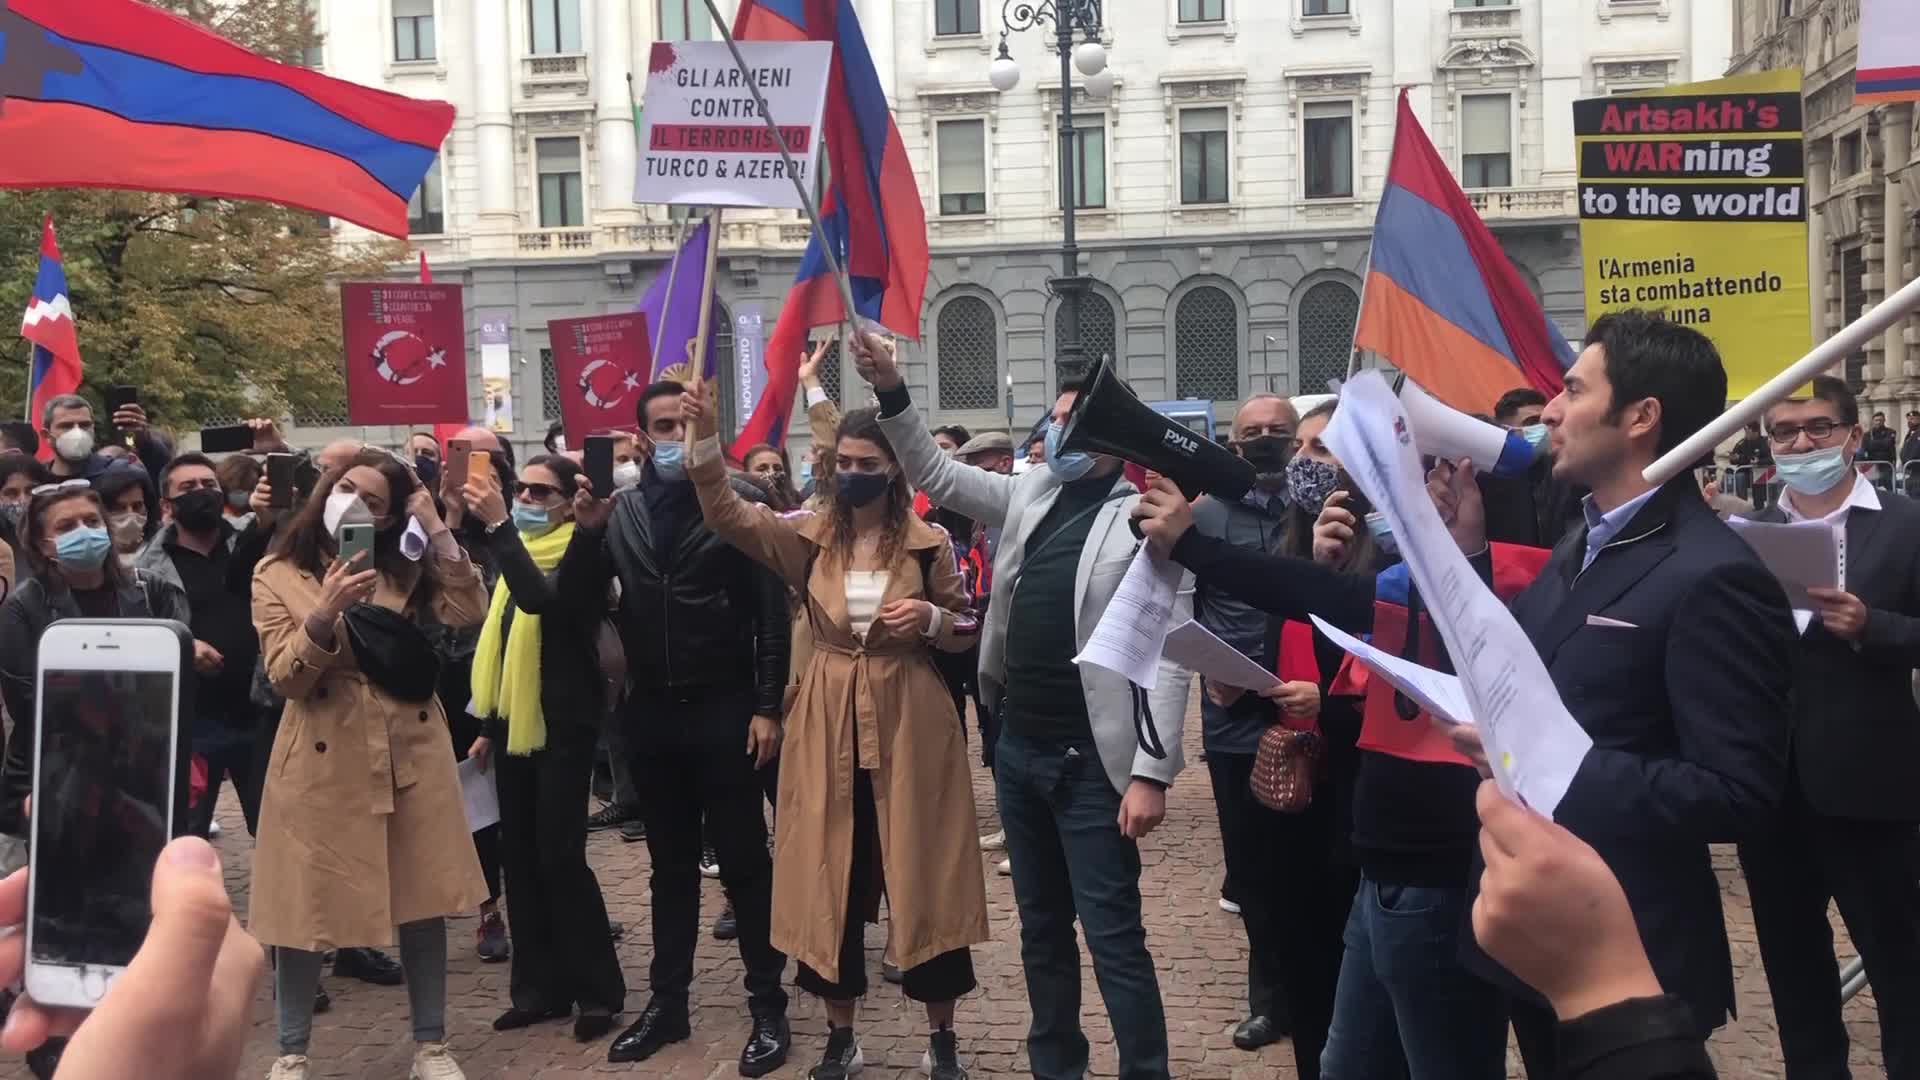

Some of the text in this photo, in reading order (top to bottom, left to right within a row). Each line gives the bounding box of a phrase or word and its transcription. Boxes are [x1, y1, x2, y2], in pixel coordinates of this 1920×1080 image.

[677, 68, 707, 87] GLI
[691, 98, 769, 118] CONTRO
[1600, 99, 1780, 133] Artsakh's
[652, 128, 668, 146] IL
[646, 158, 708, 177] TURCO
[715, 159, 727, 178] &
[1603, 142, 1774, 177] WARning
[1582, 186, 1801, 215] to the world
[1599, 252, 1696, 279] l'Armenia
[1600, 271, 1782, 305] sta combattendo
[1671, 307, 1711, 325] una
[741, 338, 752, 408] NOVECENTO
[1164, 428, 1200, 453] PYLE
